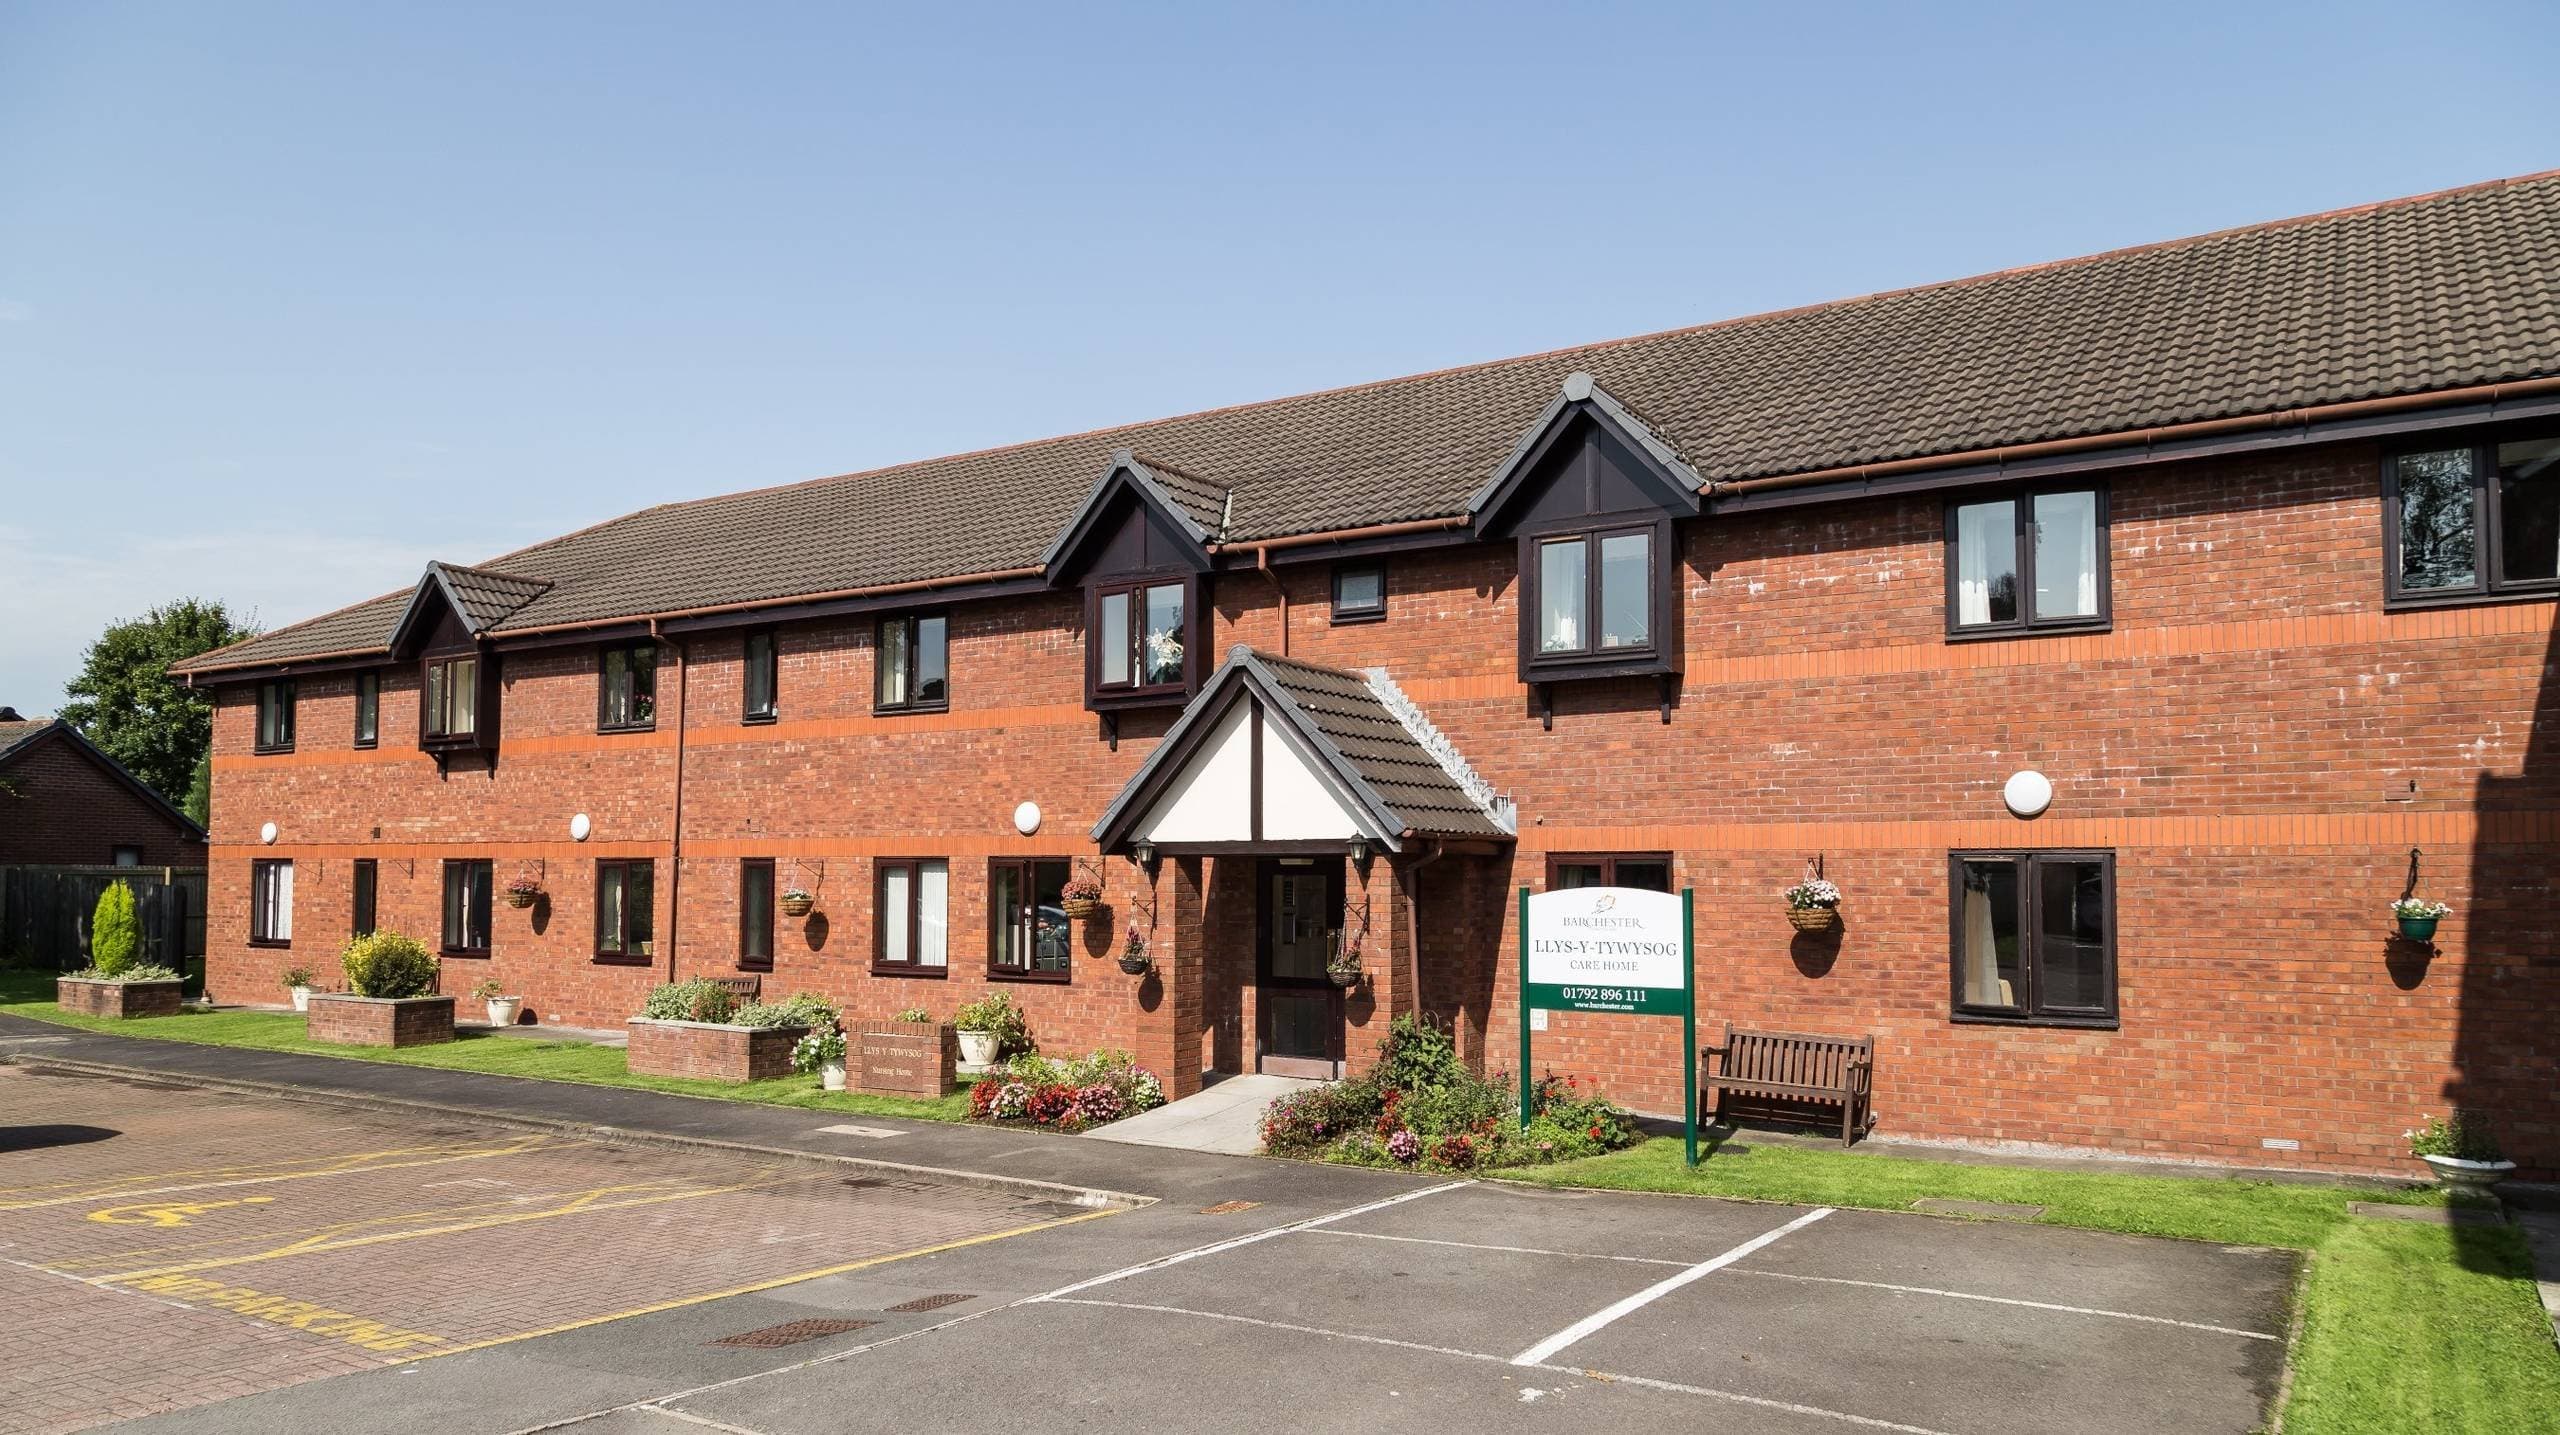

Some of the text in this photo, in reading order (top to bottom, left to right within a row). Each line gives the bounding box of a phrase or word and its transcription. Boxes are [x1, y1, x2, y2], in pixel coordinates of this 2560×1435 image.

[1563, 917, 1645, 929] BARCHESTER
[1535, 939, 1678, 956] LLYS-Y-TYWYSOG
[1570, 960, 1639, 972] CARE HOME
[1563, 987, 1647, 1002] 01792 896 111
[1574, 1001, 1634, 1010] www.barchester.com
